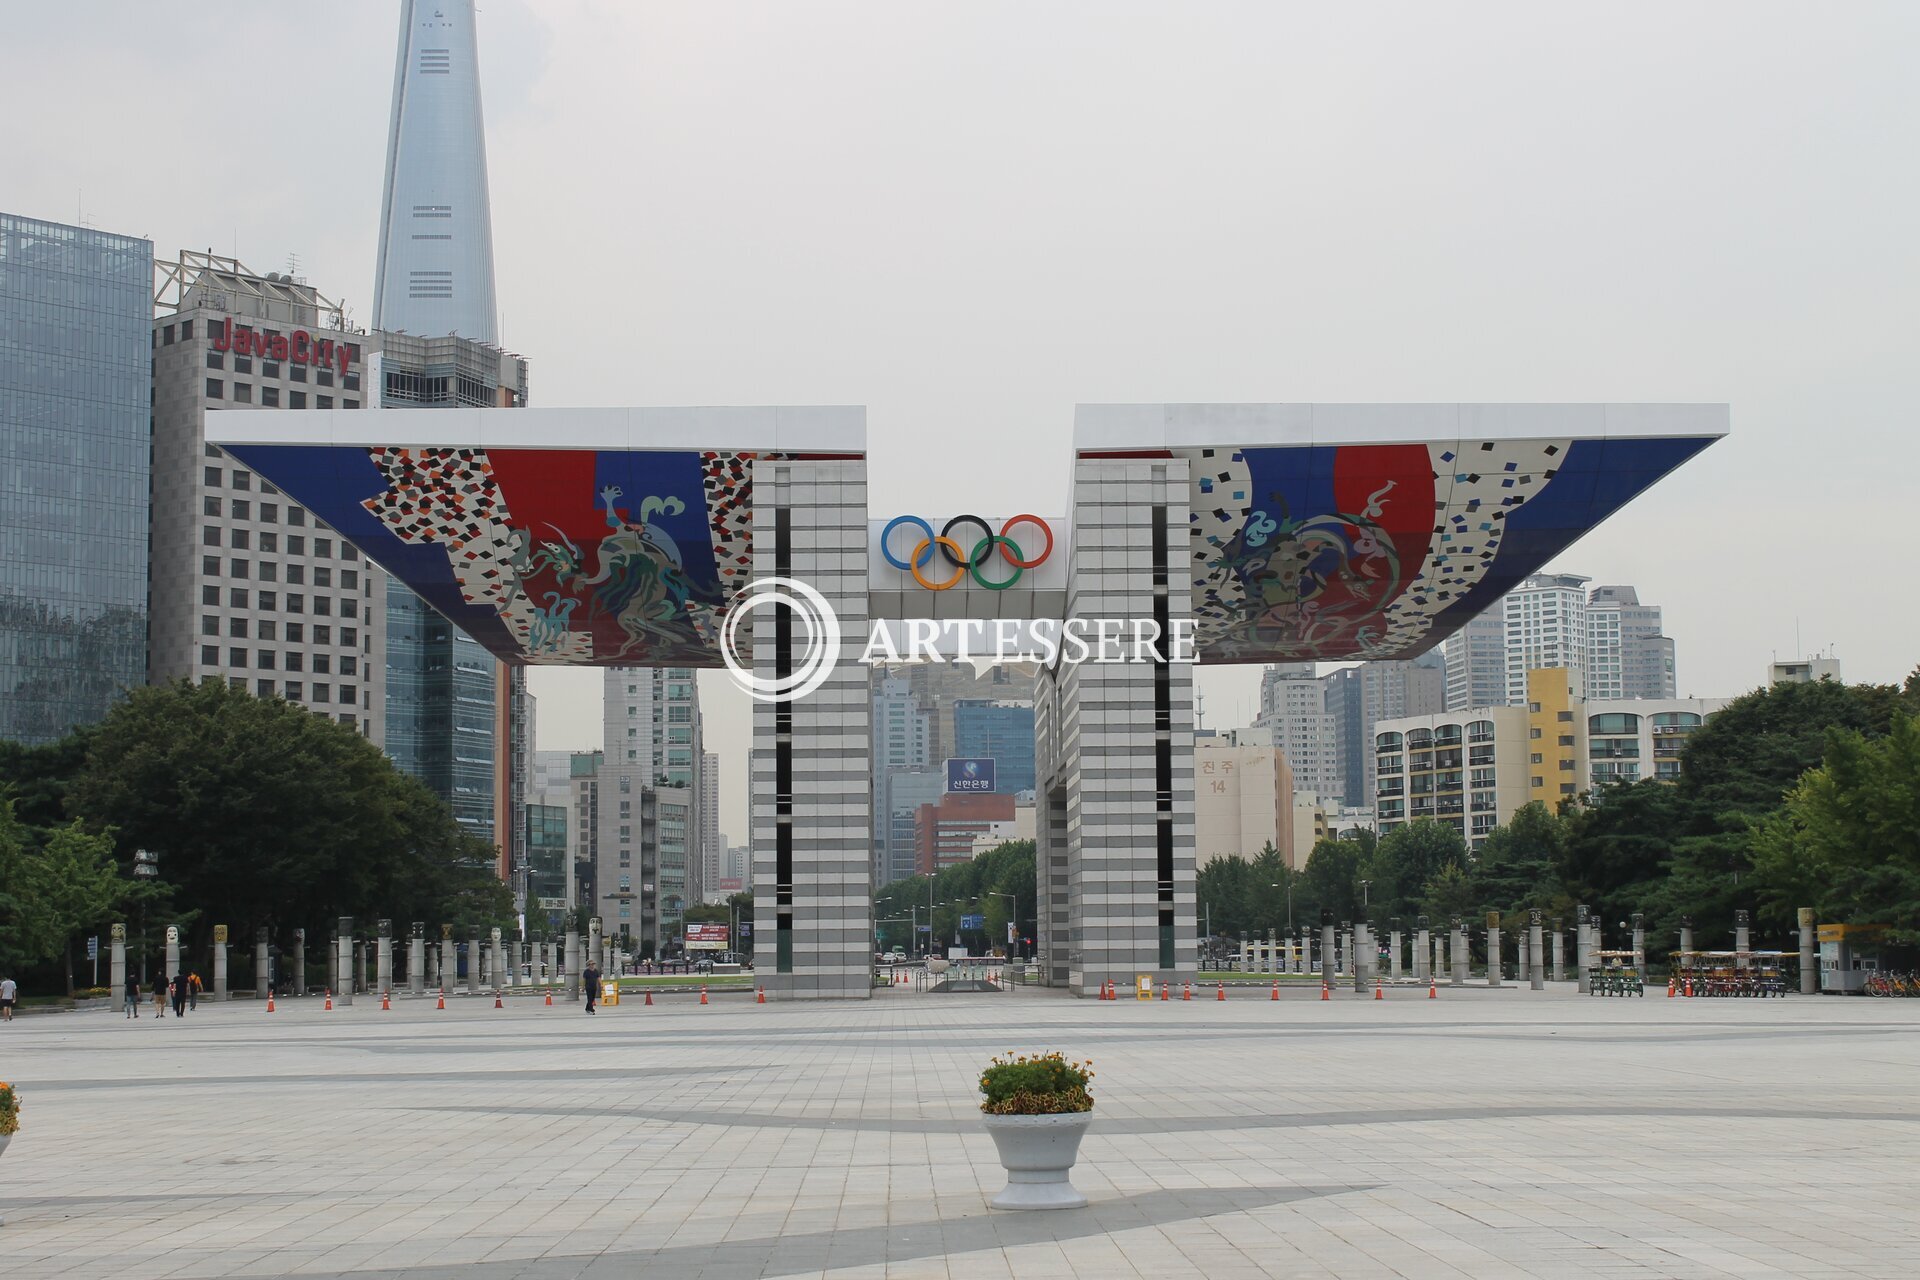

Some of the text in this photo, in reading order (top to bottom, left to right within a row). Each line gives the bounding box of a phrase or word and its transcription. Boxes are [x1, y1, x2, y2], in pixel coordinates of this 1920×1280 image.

[214, 317, 352, 377] JavaCity
[953, 780, 989, 789] 신한은행
[1210, 780, 1226, 793] 14
